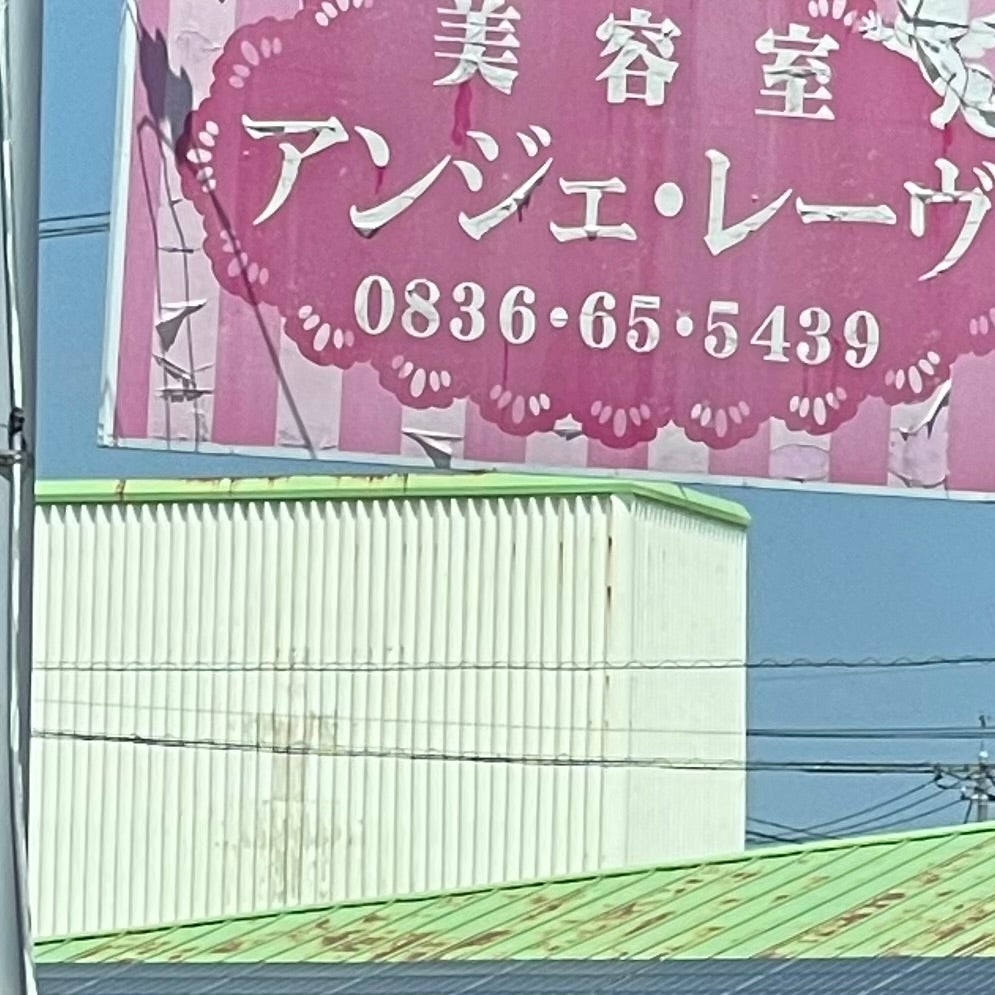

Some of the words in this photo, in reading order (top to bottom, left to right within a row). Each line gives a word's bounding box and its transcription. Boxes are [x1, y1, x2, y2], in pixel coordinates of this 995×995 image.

[432, 0, 840, 121] 美容室
[354, 275, 881, 370] 0836・65・5439
